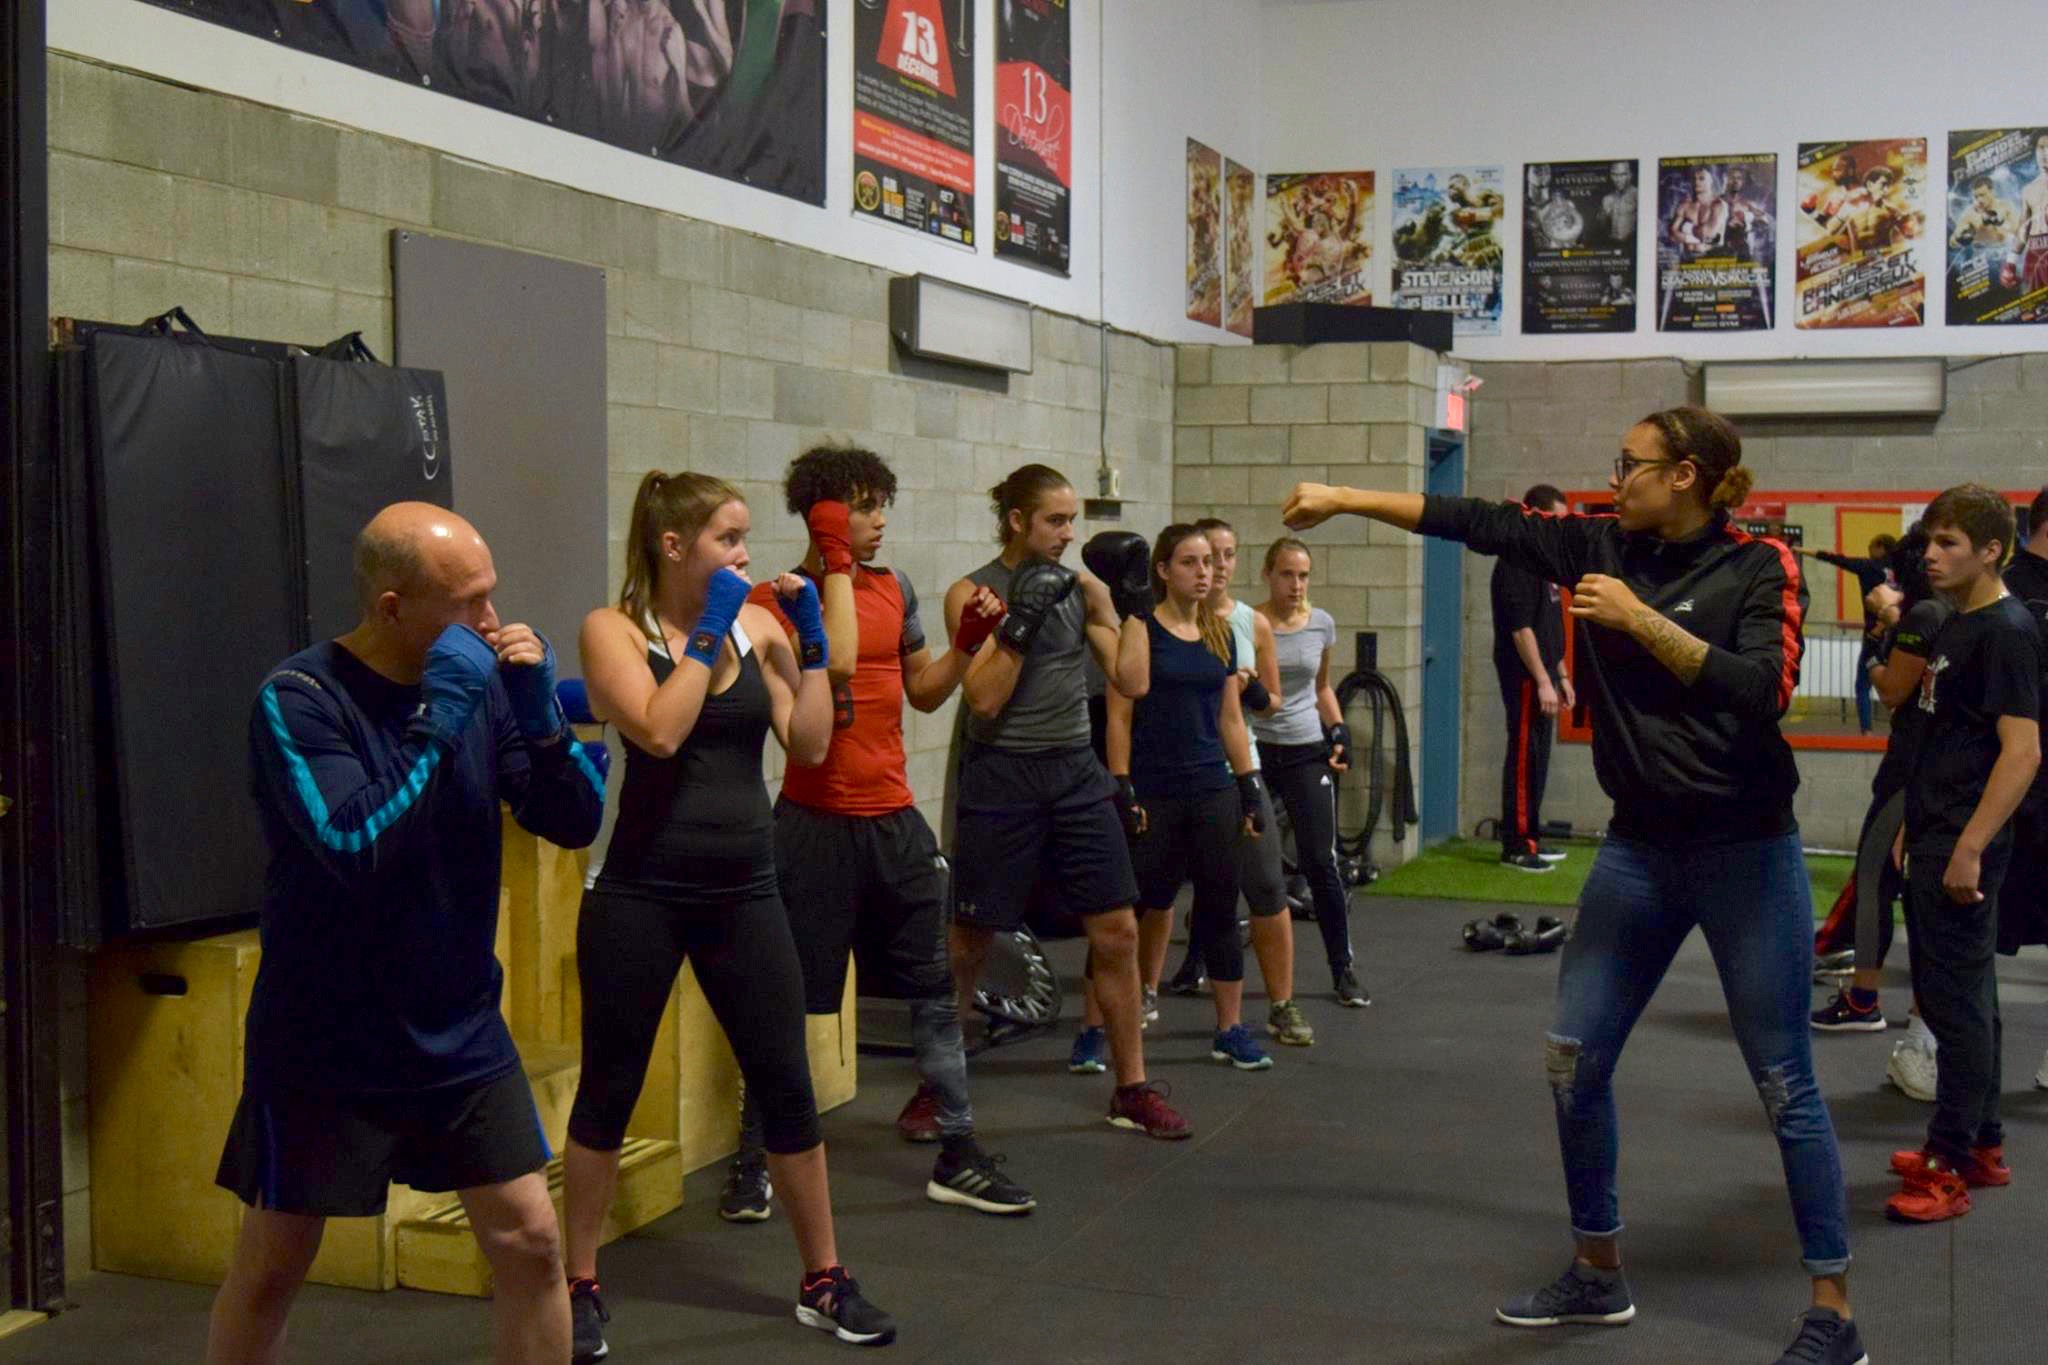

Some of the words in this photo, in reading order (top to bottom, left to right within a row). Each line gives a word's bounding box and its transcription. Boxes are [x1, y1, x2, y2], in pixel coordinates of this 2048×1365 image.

[902, 11, 938, 65] 13
[1022, 67, 1048, 124] 13
[1401, 270, 1493, 287] STEVENSON
[1803, 263, 1883, 299] RAPIDES
[1886, 248, 1915, 267] ET
[1803, 260, 1918, 315] DANGEREUX
